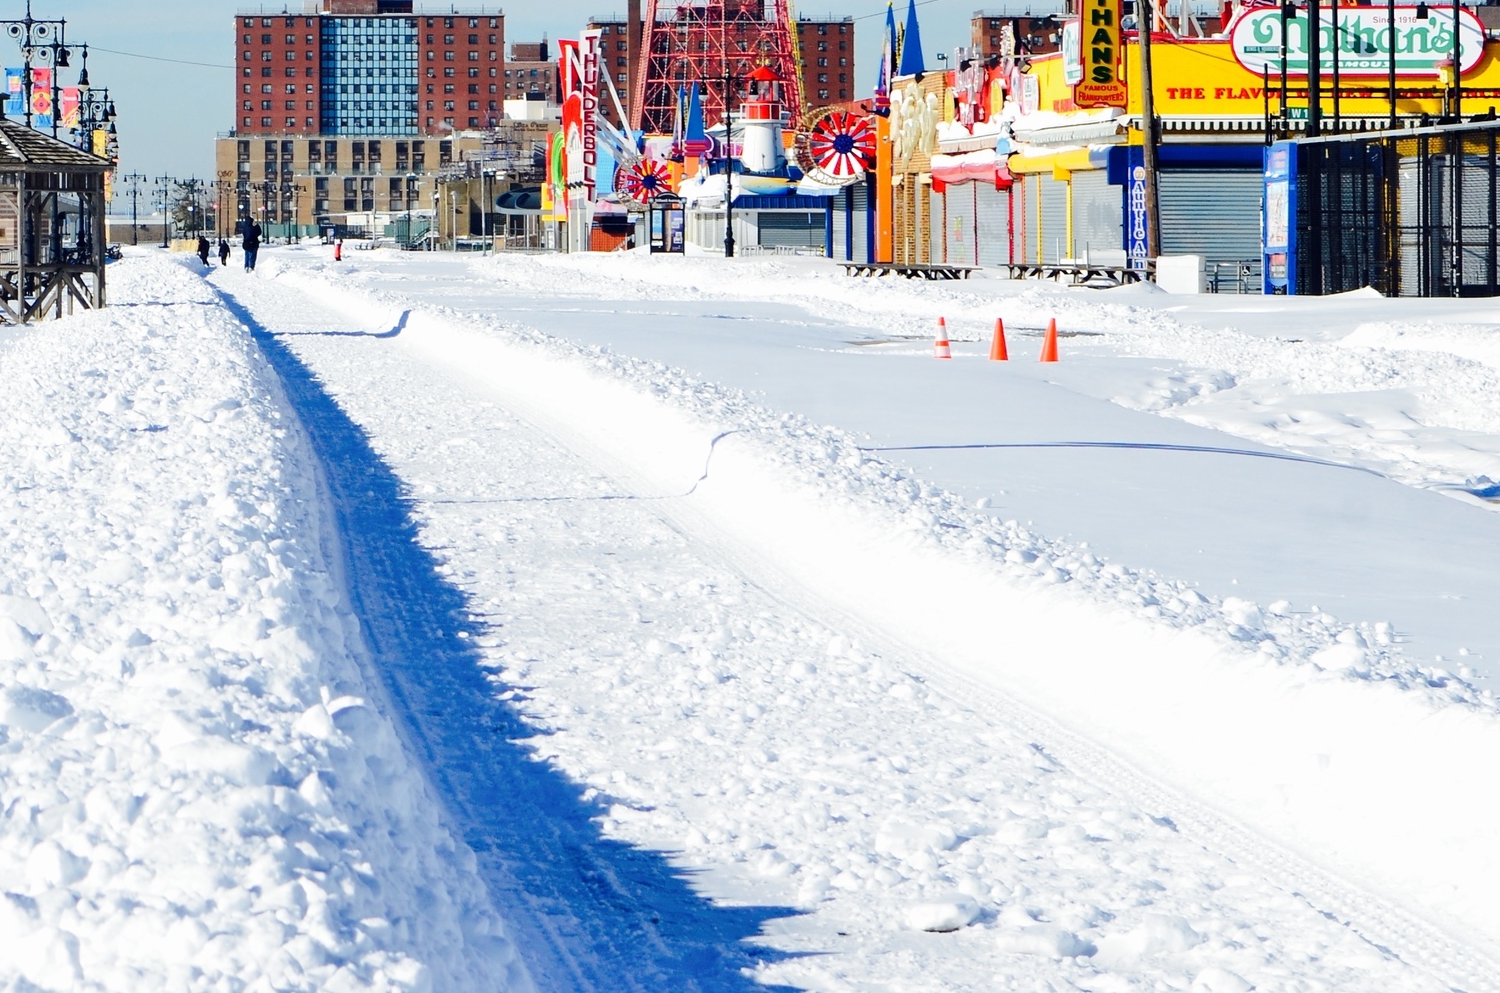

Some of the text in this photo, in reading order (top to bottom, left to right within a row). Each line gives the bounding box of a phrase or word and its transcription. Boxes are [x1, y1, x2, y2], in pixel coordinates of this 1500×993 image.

[1399, 16, 1417, 24] 1916
[1166, 87, 1206, 100] THE
[583, 36, 598, 202] THUNDERBOLT
[1291, 109, 1302, 118] W
